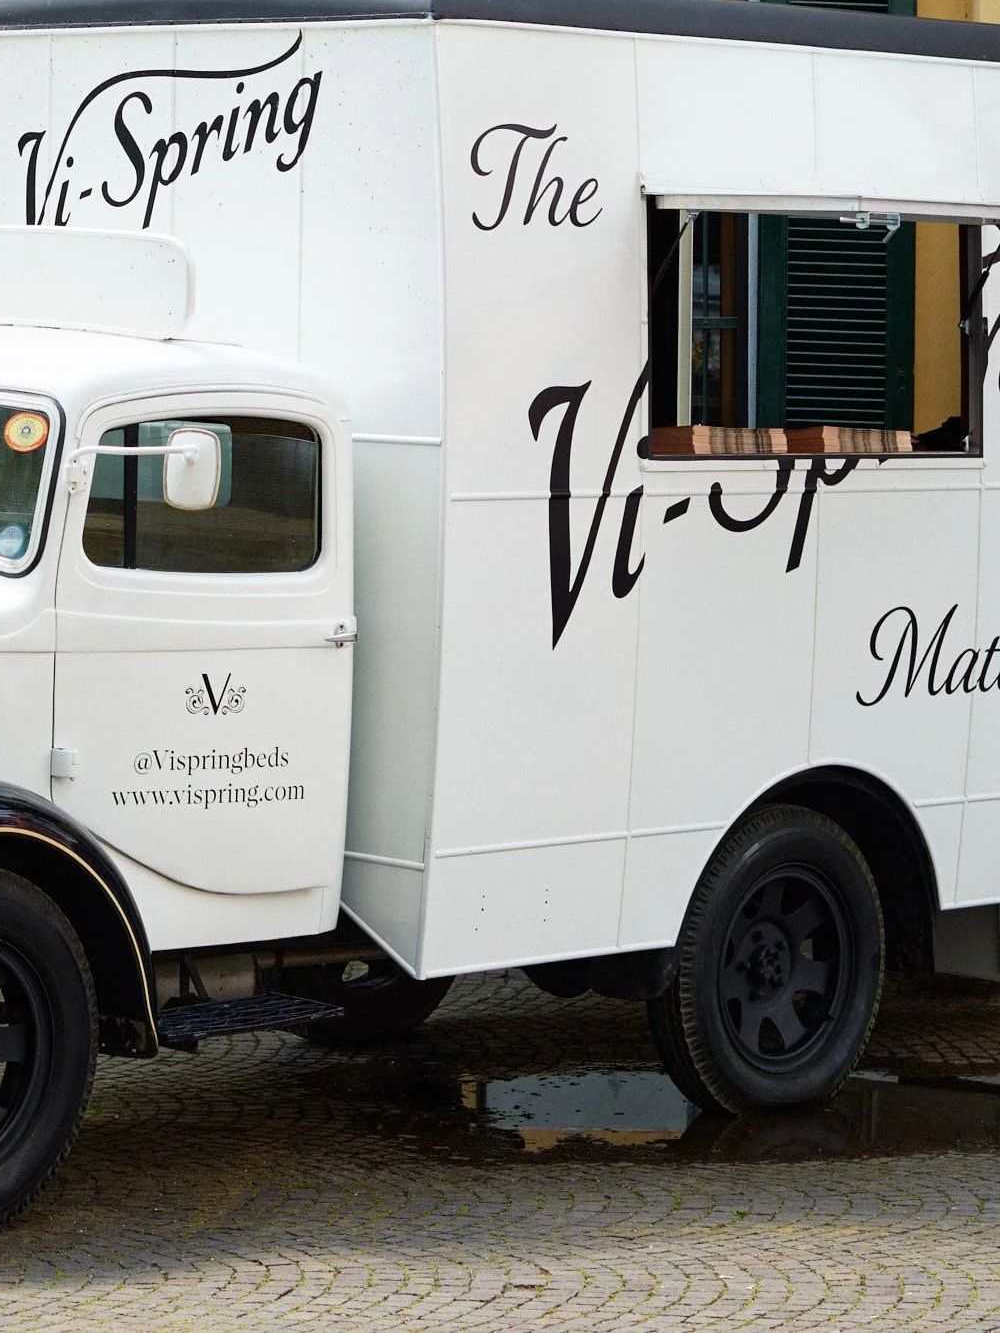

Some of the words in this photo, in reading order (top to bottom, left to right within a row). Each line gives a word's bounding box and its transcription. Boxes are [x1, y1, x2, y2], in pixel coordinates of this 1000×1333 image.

[18, 29, 323, 229] Vi-Spring
[470, 123, 603, 230] The
[856, 603, 1000, 706] Mat
[202, 673, 232, 715] V
[111, 783, 306, 809] www.vispring.com
[133, 746, 290, 775] @Vispringbeds
